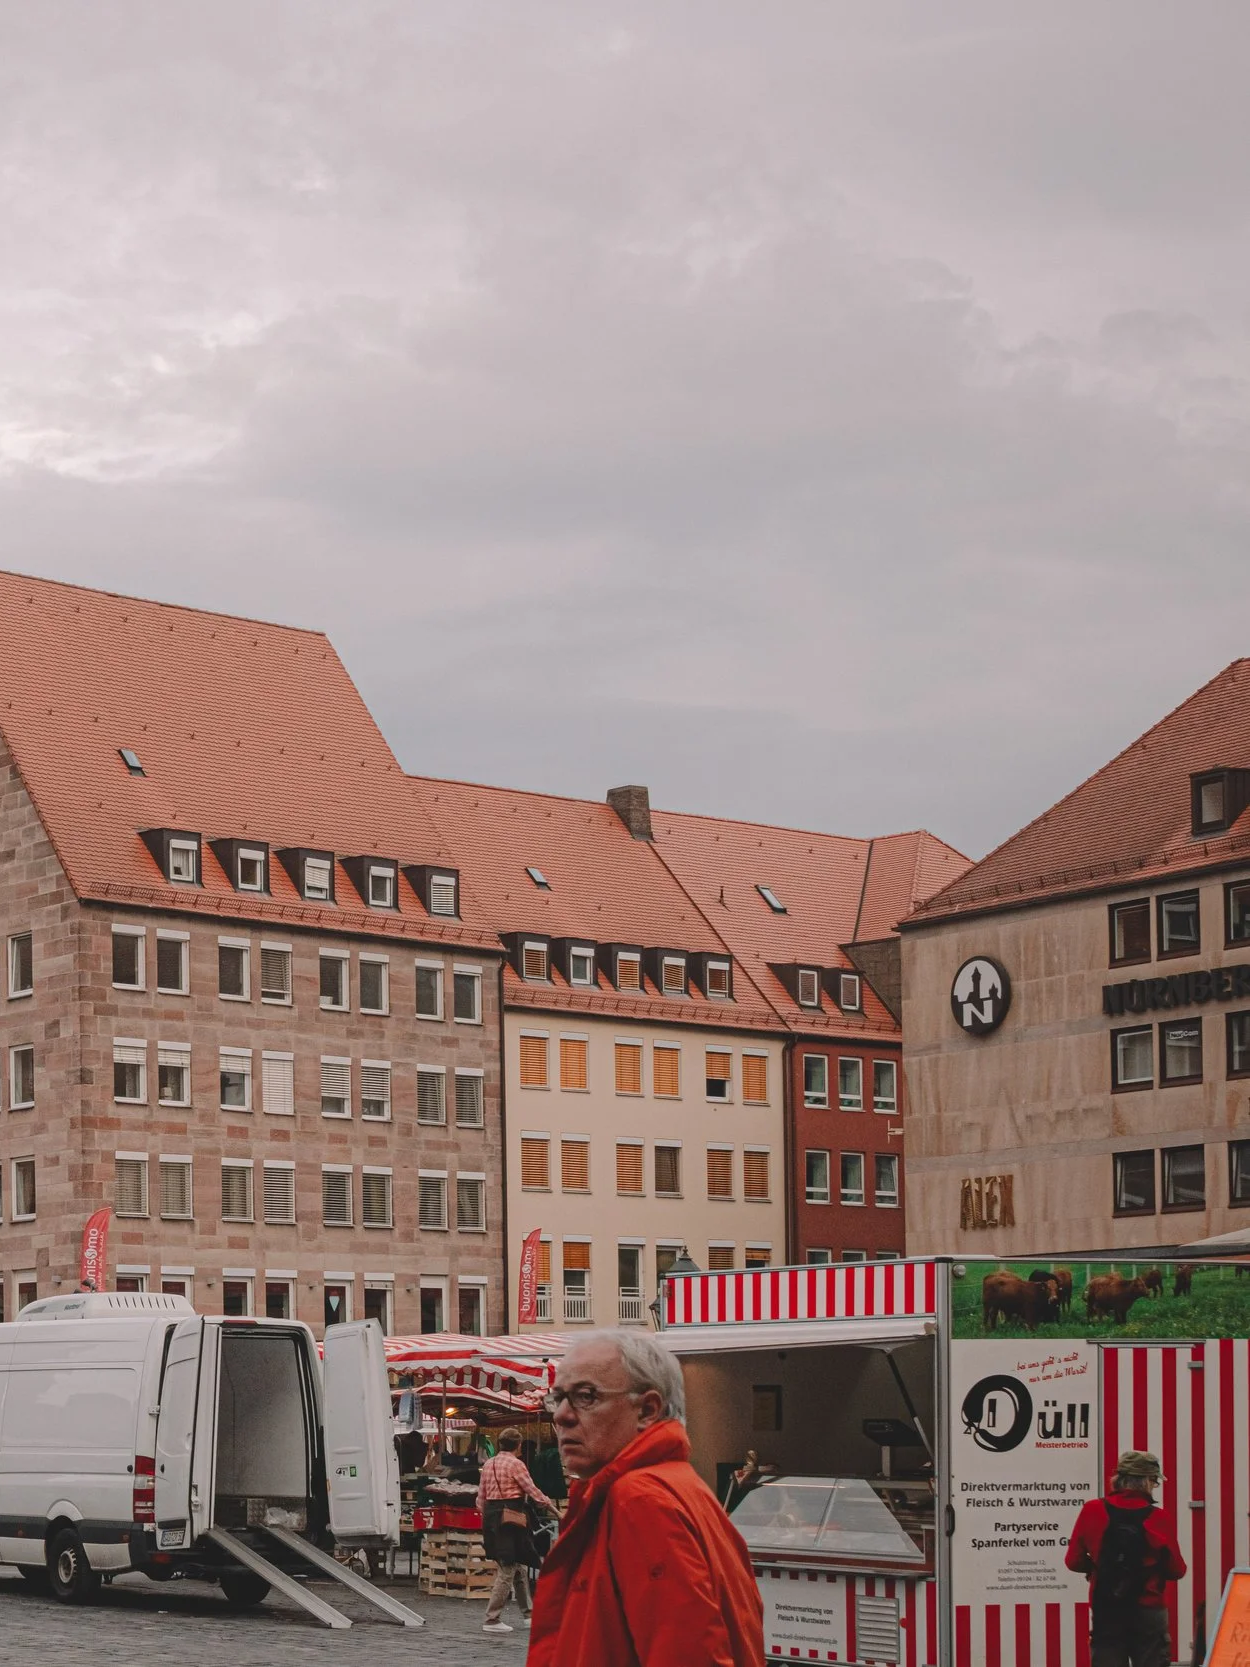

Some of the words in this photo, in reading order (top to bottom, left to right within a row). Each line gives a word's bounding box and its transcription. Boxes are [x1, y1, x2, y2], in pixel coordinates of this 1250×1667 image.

[962, 999, 994, 1028] N
[960, 1174, 1015, 1231] ALEX
[961, 1374, 1090, 1453] Düll
[1035, 1441, 1089, 1449] Meisterbetrieb
[960, 1482, 1066, 1493] Direktvermarktung
[1070, 1482, 1090, 1491] von
[966, 1498, 1003, 1508] Fleisch
[1007, 1498, 1015, 1507] &
[1019, 1497, 1085, 1507] Wurstwaren
[994, 1522, 1059, 1534] Partyservice
[971, 1538, 1029, 1550] Spanferkel
[1033, 1538, 1056, 1547] vom
[774, 1603, 823, 1616] Direktvermarktung
